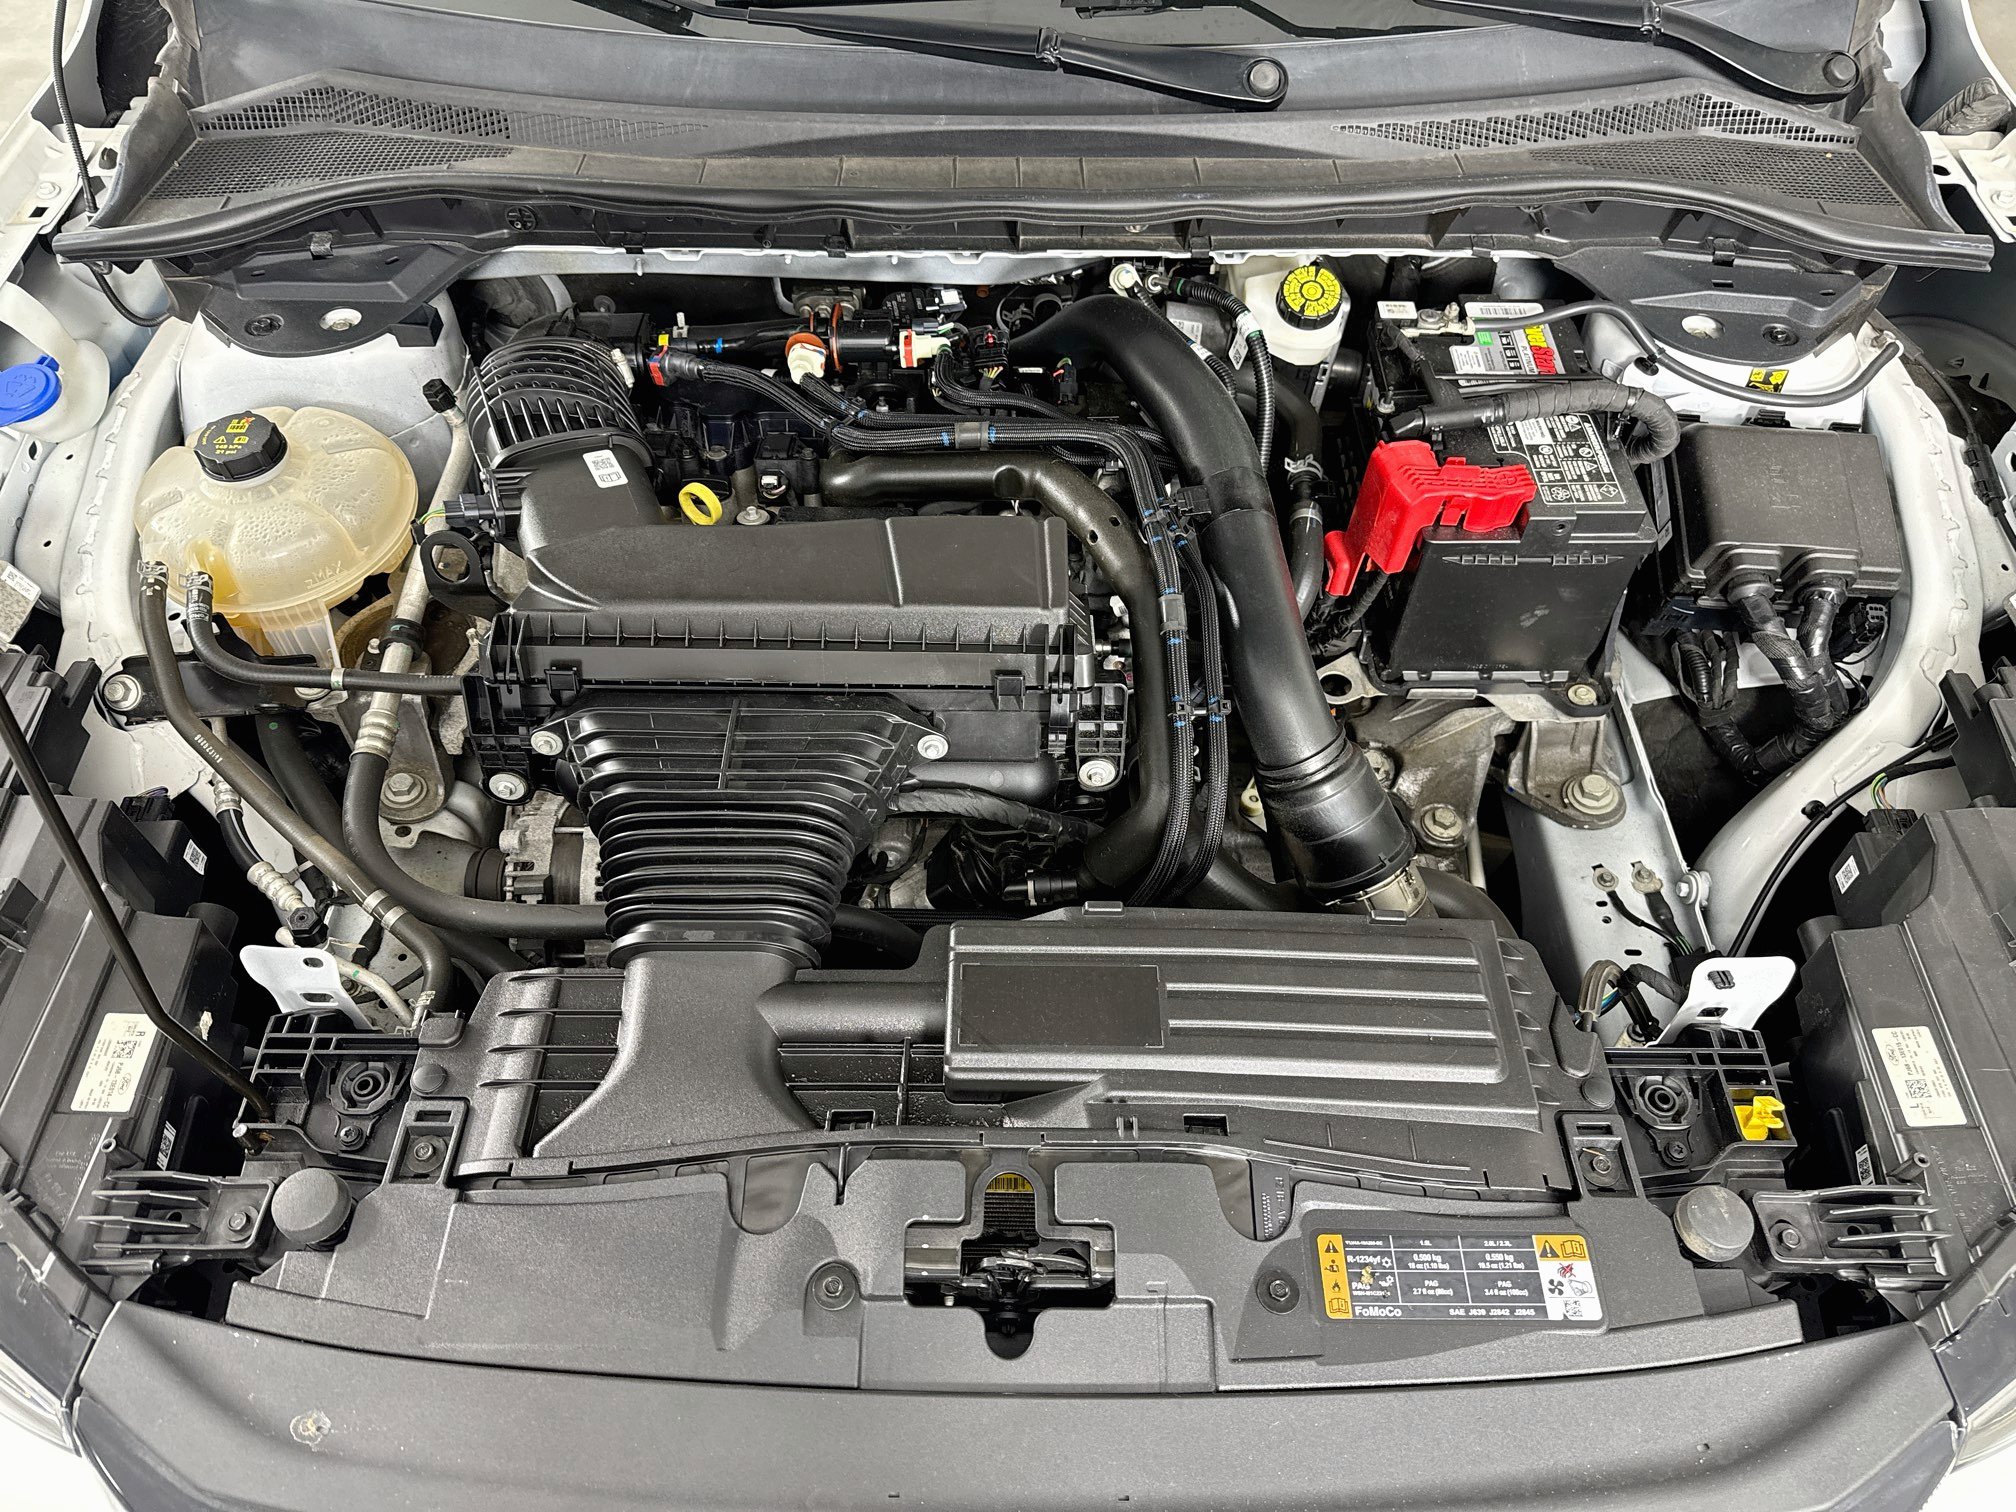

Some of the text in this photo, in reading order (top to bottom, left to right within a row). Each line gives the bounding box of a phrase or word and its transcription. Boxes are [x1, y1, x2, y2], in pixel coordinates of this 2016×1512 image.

[1347, 1255, 1381, 1265] R-1234yf
[1432, 1254, 1442, 1262] kg
[1504, 1253, 1514, 1262] kg
[1352, 1281, 1371, 1290] PAG
[1355, 1306, 1402, 1317] FoMoCo
[1449, 1308, 1466, 1316] SAE
